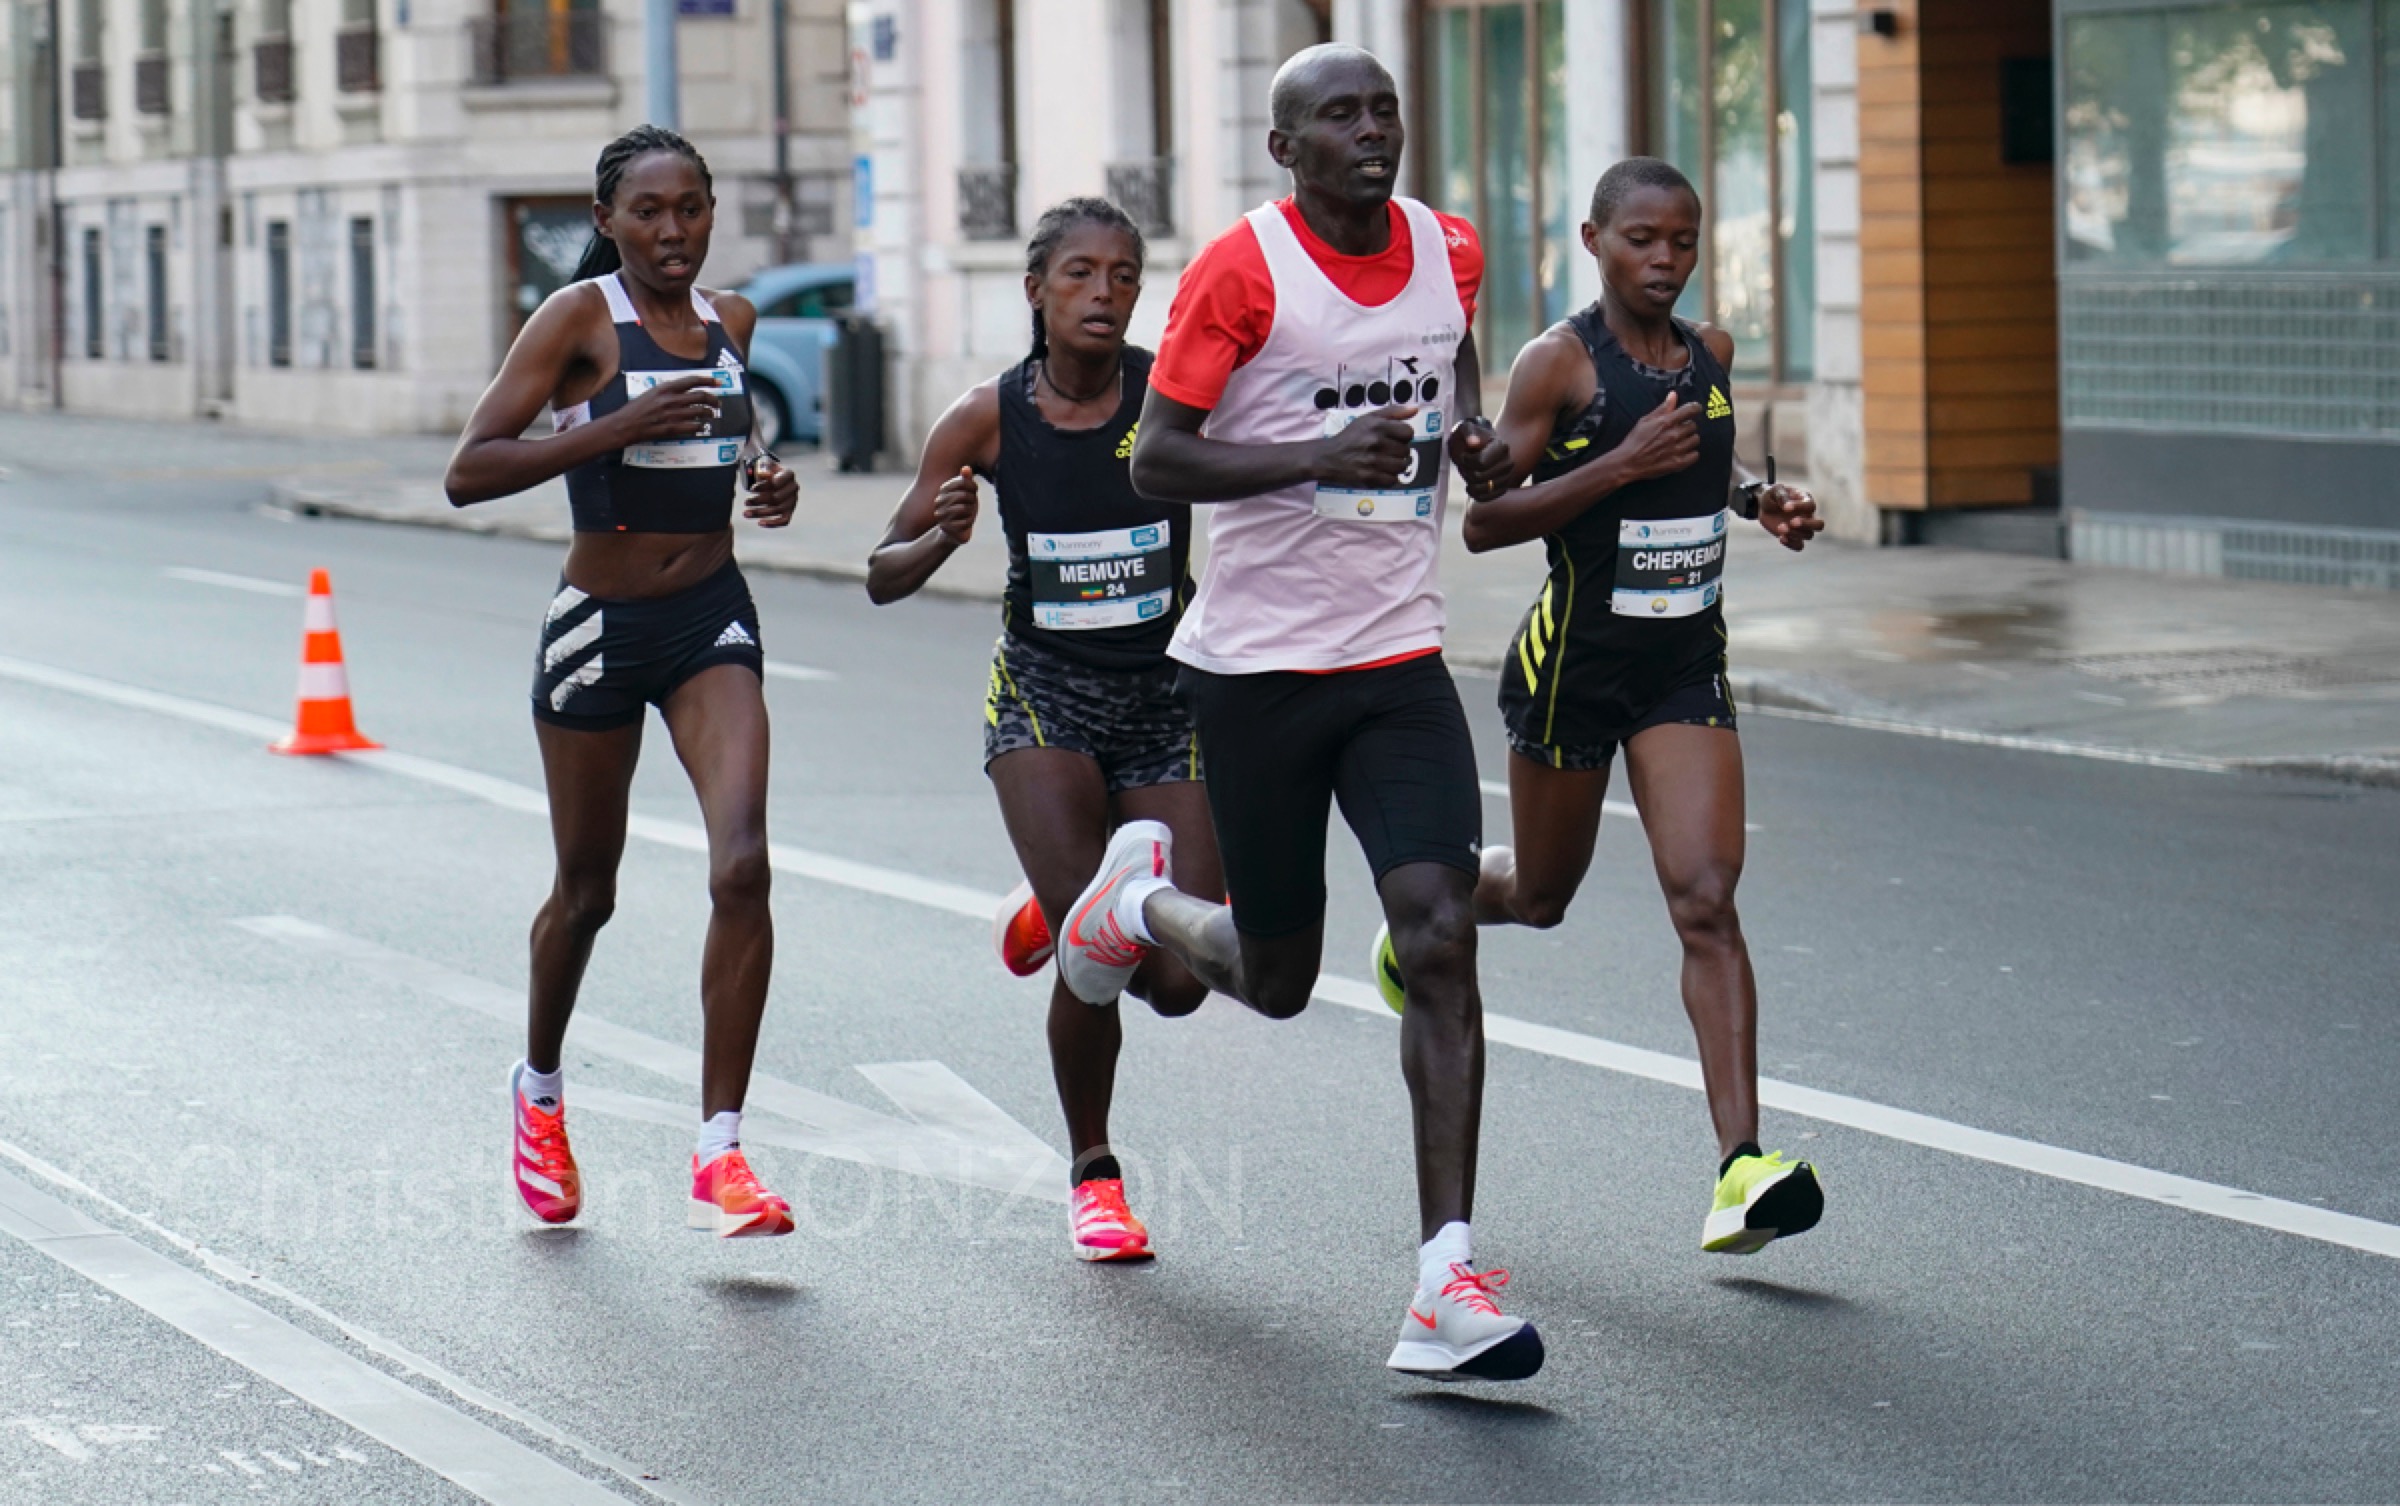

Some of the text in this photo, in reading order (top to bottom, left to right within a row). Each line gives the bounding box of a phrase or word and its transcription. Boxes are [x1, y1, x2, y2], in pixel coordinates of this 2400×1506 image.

[1314, 356, 1440, 410] diadora
[1059, 557, 1146, 583] MEMUYE
[1105, 583, 1126, 598] 24
